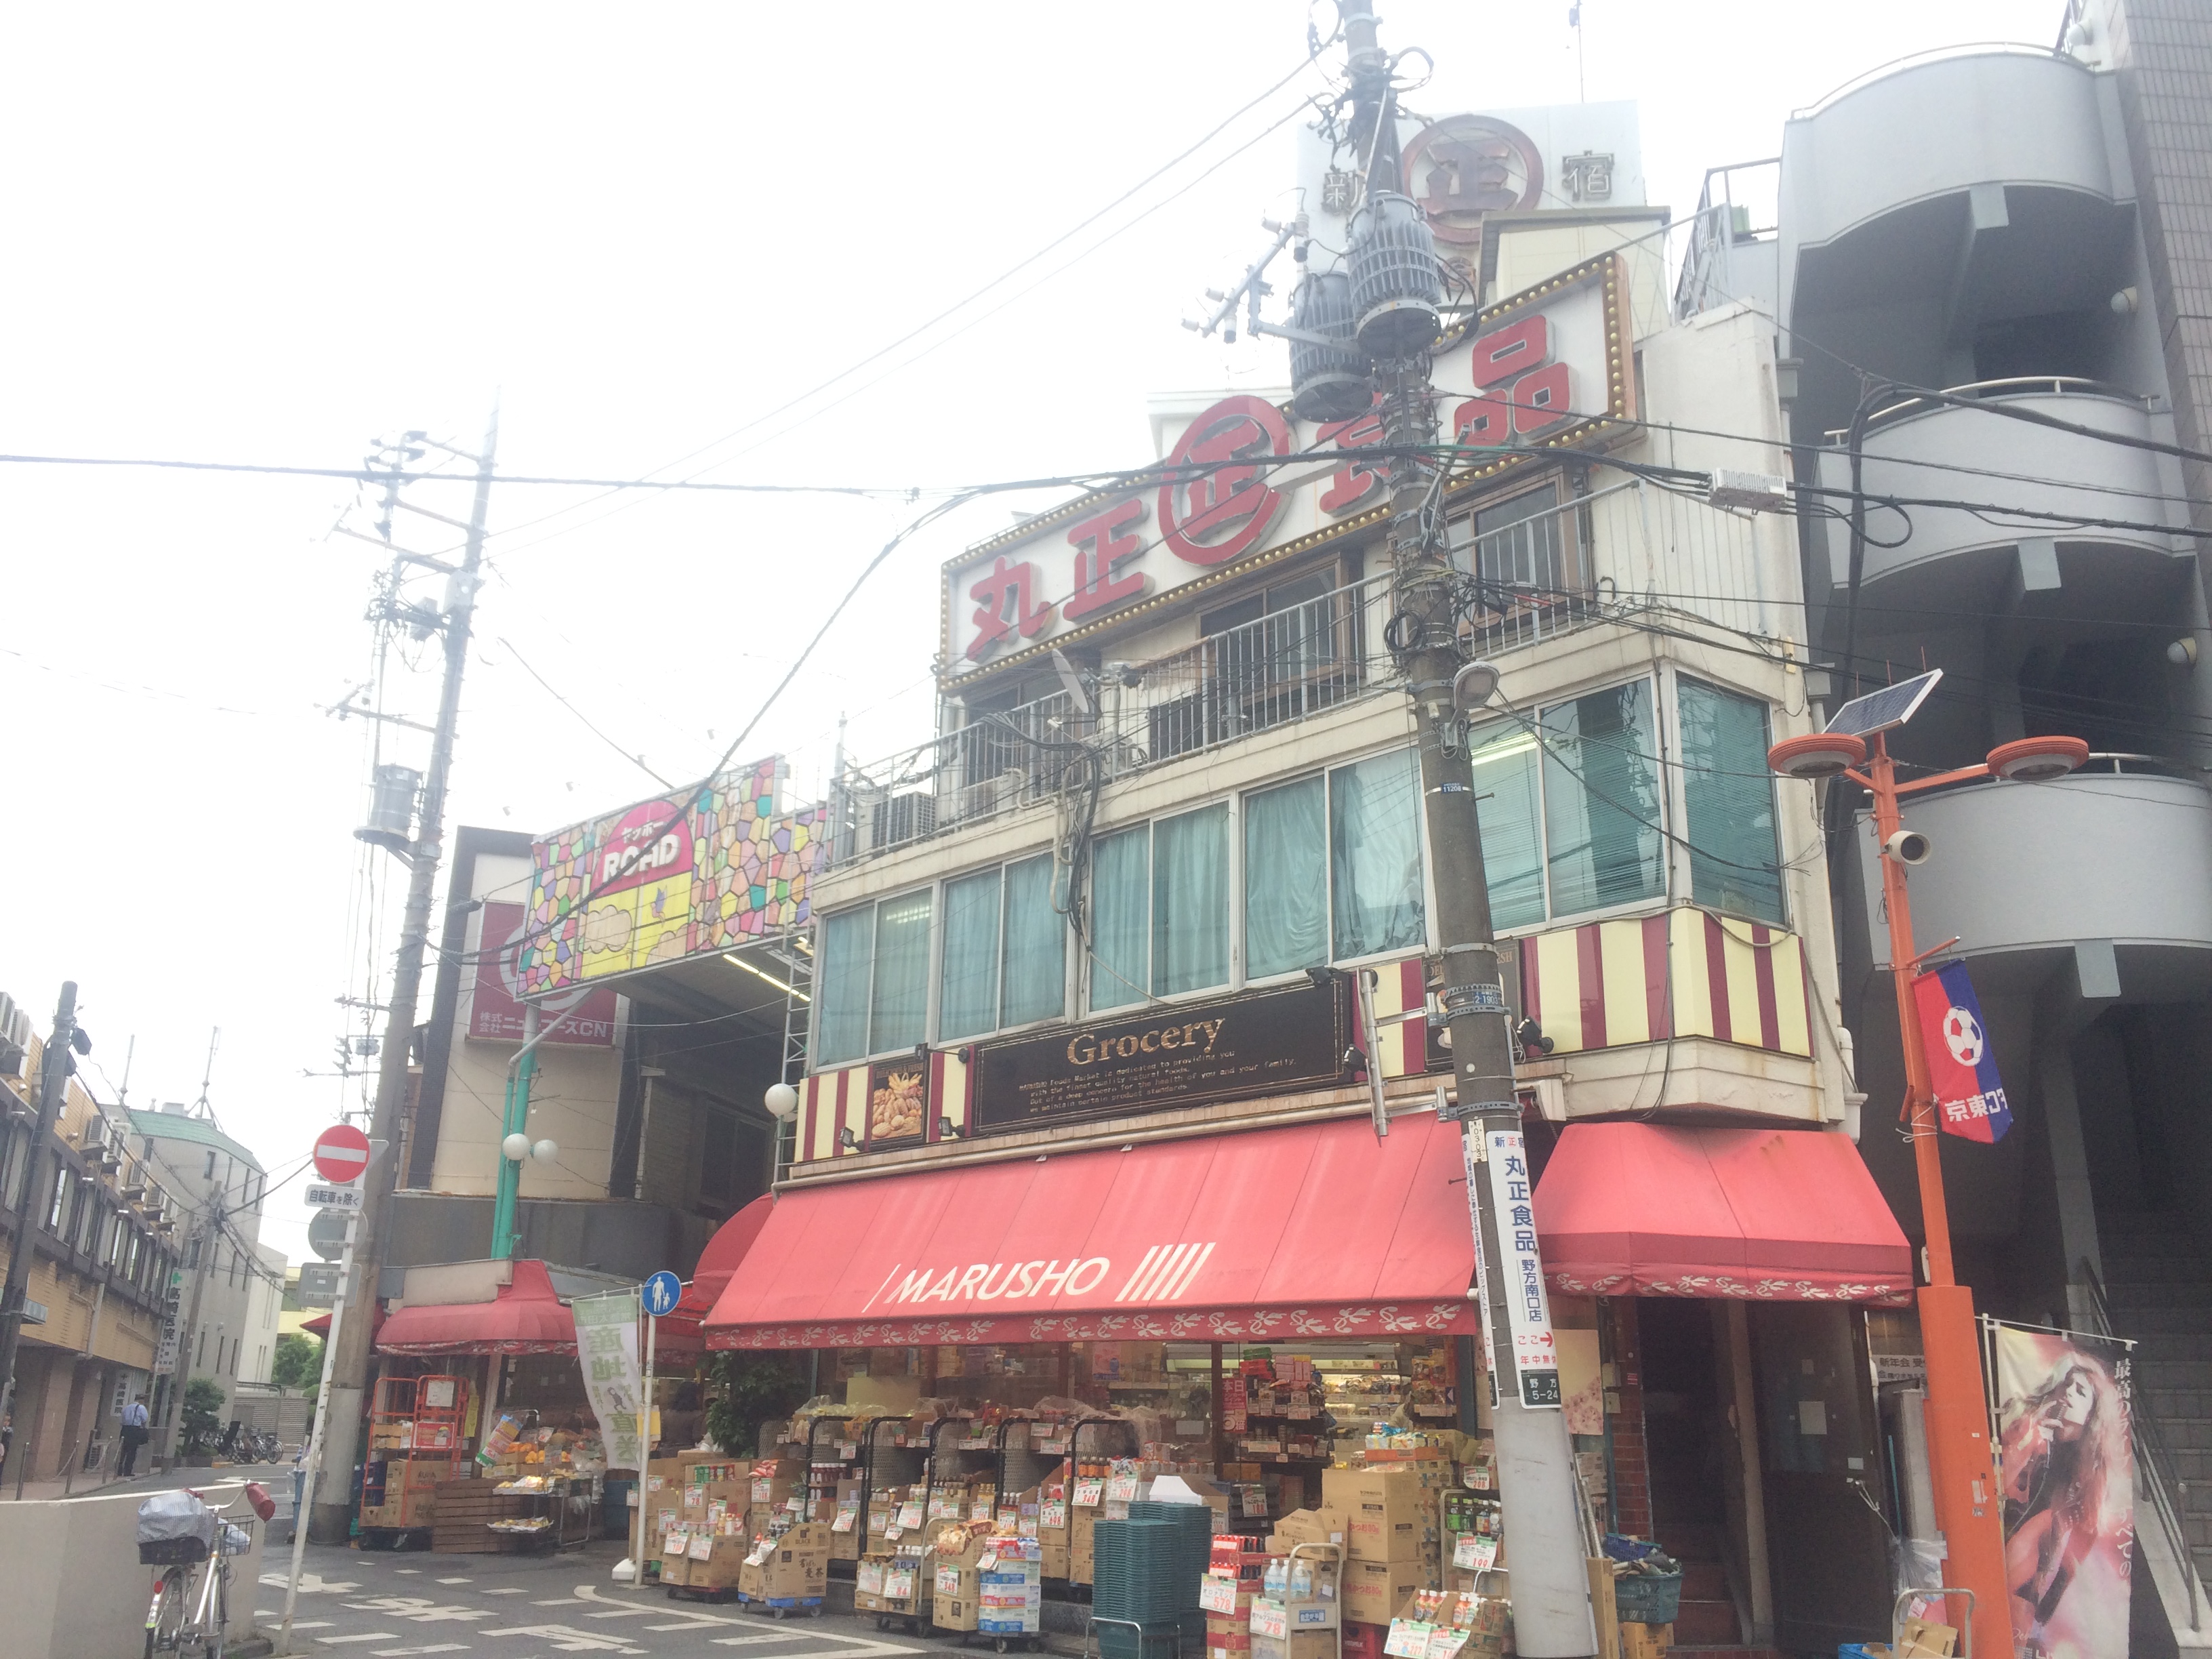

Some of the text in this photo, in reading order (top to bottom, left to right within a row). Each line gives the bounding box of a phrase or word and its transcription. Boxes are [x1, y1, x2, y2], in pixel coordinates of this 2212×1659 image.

[1563, 149, 1614, 201] 宿
[967, 499, 1147, 662] 丸正
[602, 834, 681, 883] ROAD
[479, 1012, 503, 1023] 株式
[479, 1022, 501, 1033] 会社
[1067, 1018, 1226, 1065] Grocery
[1074, 1072, 1100, 1082] Market
[1116, 1063, 1156, 1076] dedicated
[1173, 1054, 1216, 1067] providing
[1220, 1050, 1235, 1059] you
[1050, 1086, 1063, 1094] the
[1094, 1077, 1126, 1088] quality
[1129, 1069, 1160, 1082] natural
[1065, 1092, 1084, 1100] deep
[1086, 1087, 1118, 1096] concern
[1155, 1075, 1183, 1086] health
[1187, 1071, 1197, 1080] of
[1201, 1071, 1216, 1080] you
[1220, 1067, 1235, 1076] and
[1239, 1062, 1259, 1073] your
[1078, 1097, 1108, 1106] certain
[1111, 1090, 1143, 1101] product
[1494, 1136, 1504, 1148] 新
[309, 1189, 360, 1207] 自転車を除く
[1504, 1155, 1536, 1252] 丸正食品
[883, 1256, 1110, 1305] MARUSHO
[1521, 1259, 1542, 1322] 野方南口店
[1518, 1335, 1539, 1345] ここ
[1214, 1597, 1231, 1611] 578
[1264, 1620, 1281, 1635] 78
